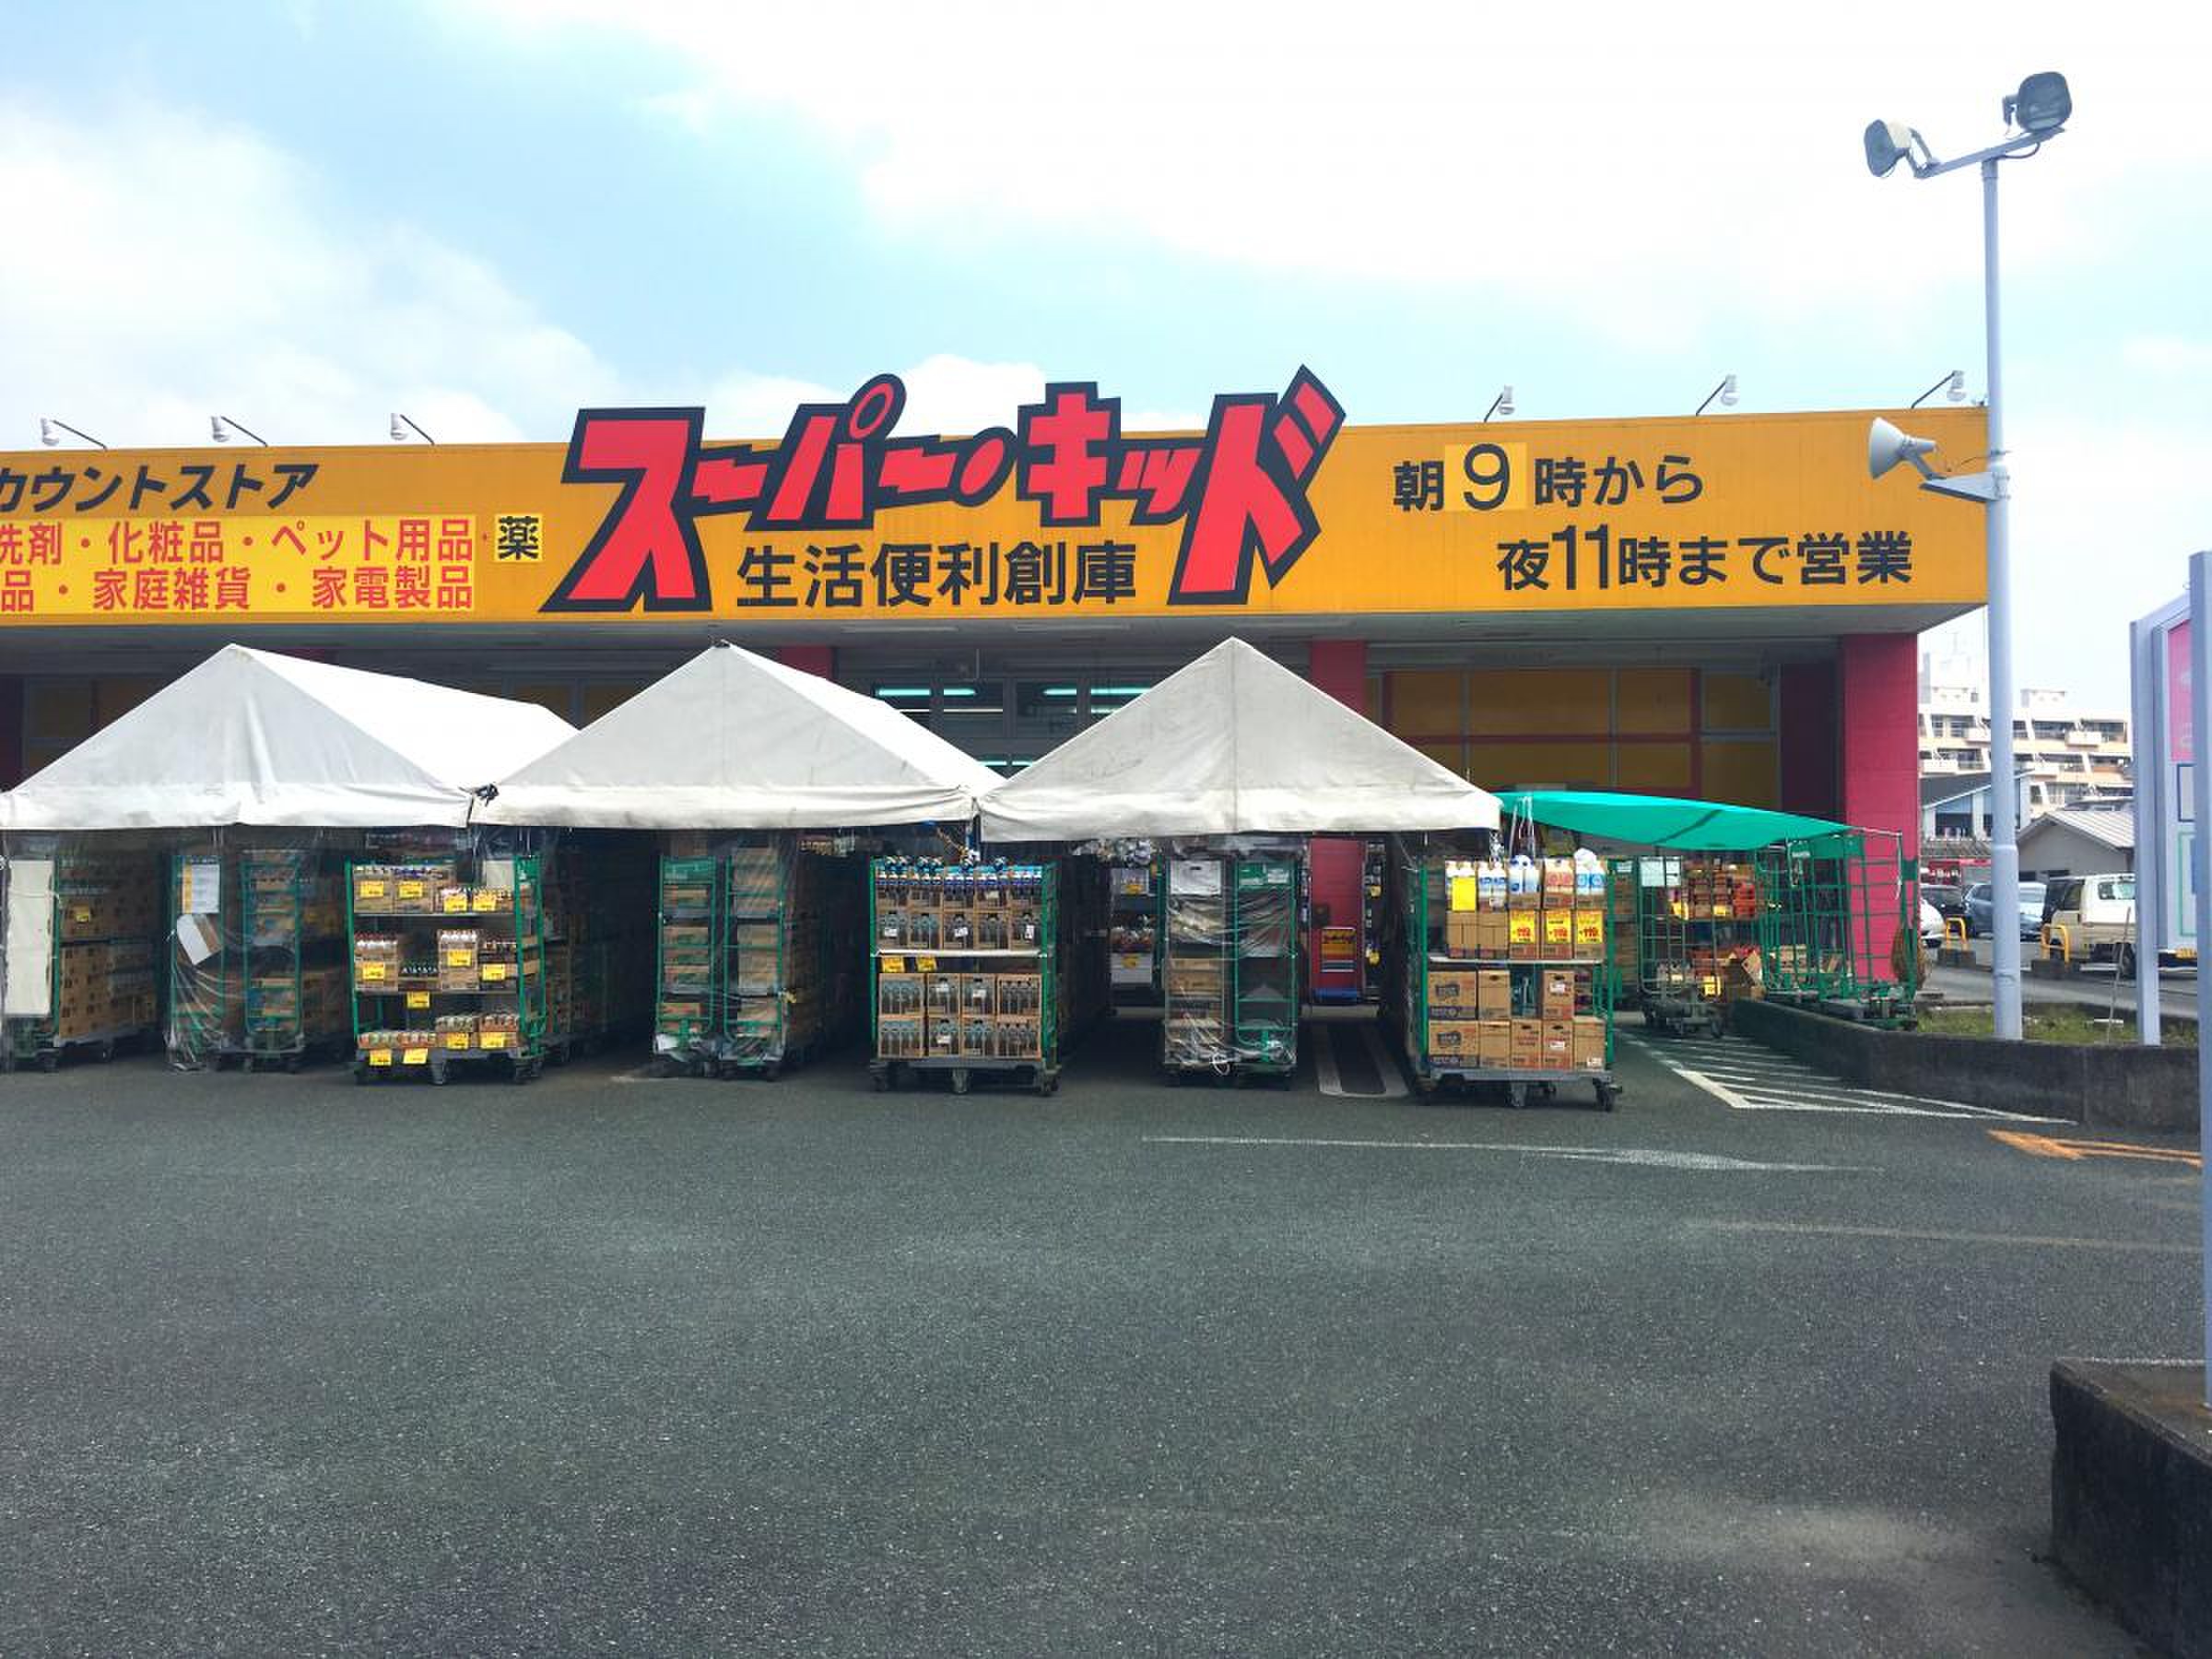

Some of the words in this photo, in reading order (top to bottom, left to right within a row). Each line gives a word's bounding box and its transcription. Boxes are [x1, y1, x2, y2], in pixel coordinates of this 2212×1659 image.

[0, 465, 319, 512] カウントストア
[498, 515, 539, 560] 薬
[1497, 524, 1912, 591] 夜11時まで営業
[736, 540, 1136, 607] 生活便利創庫
